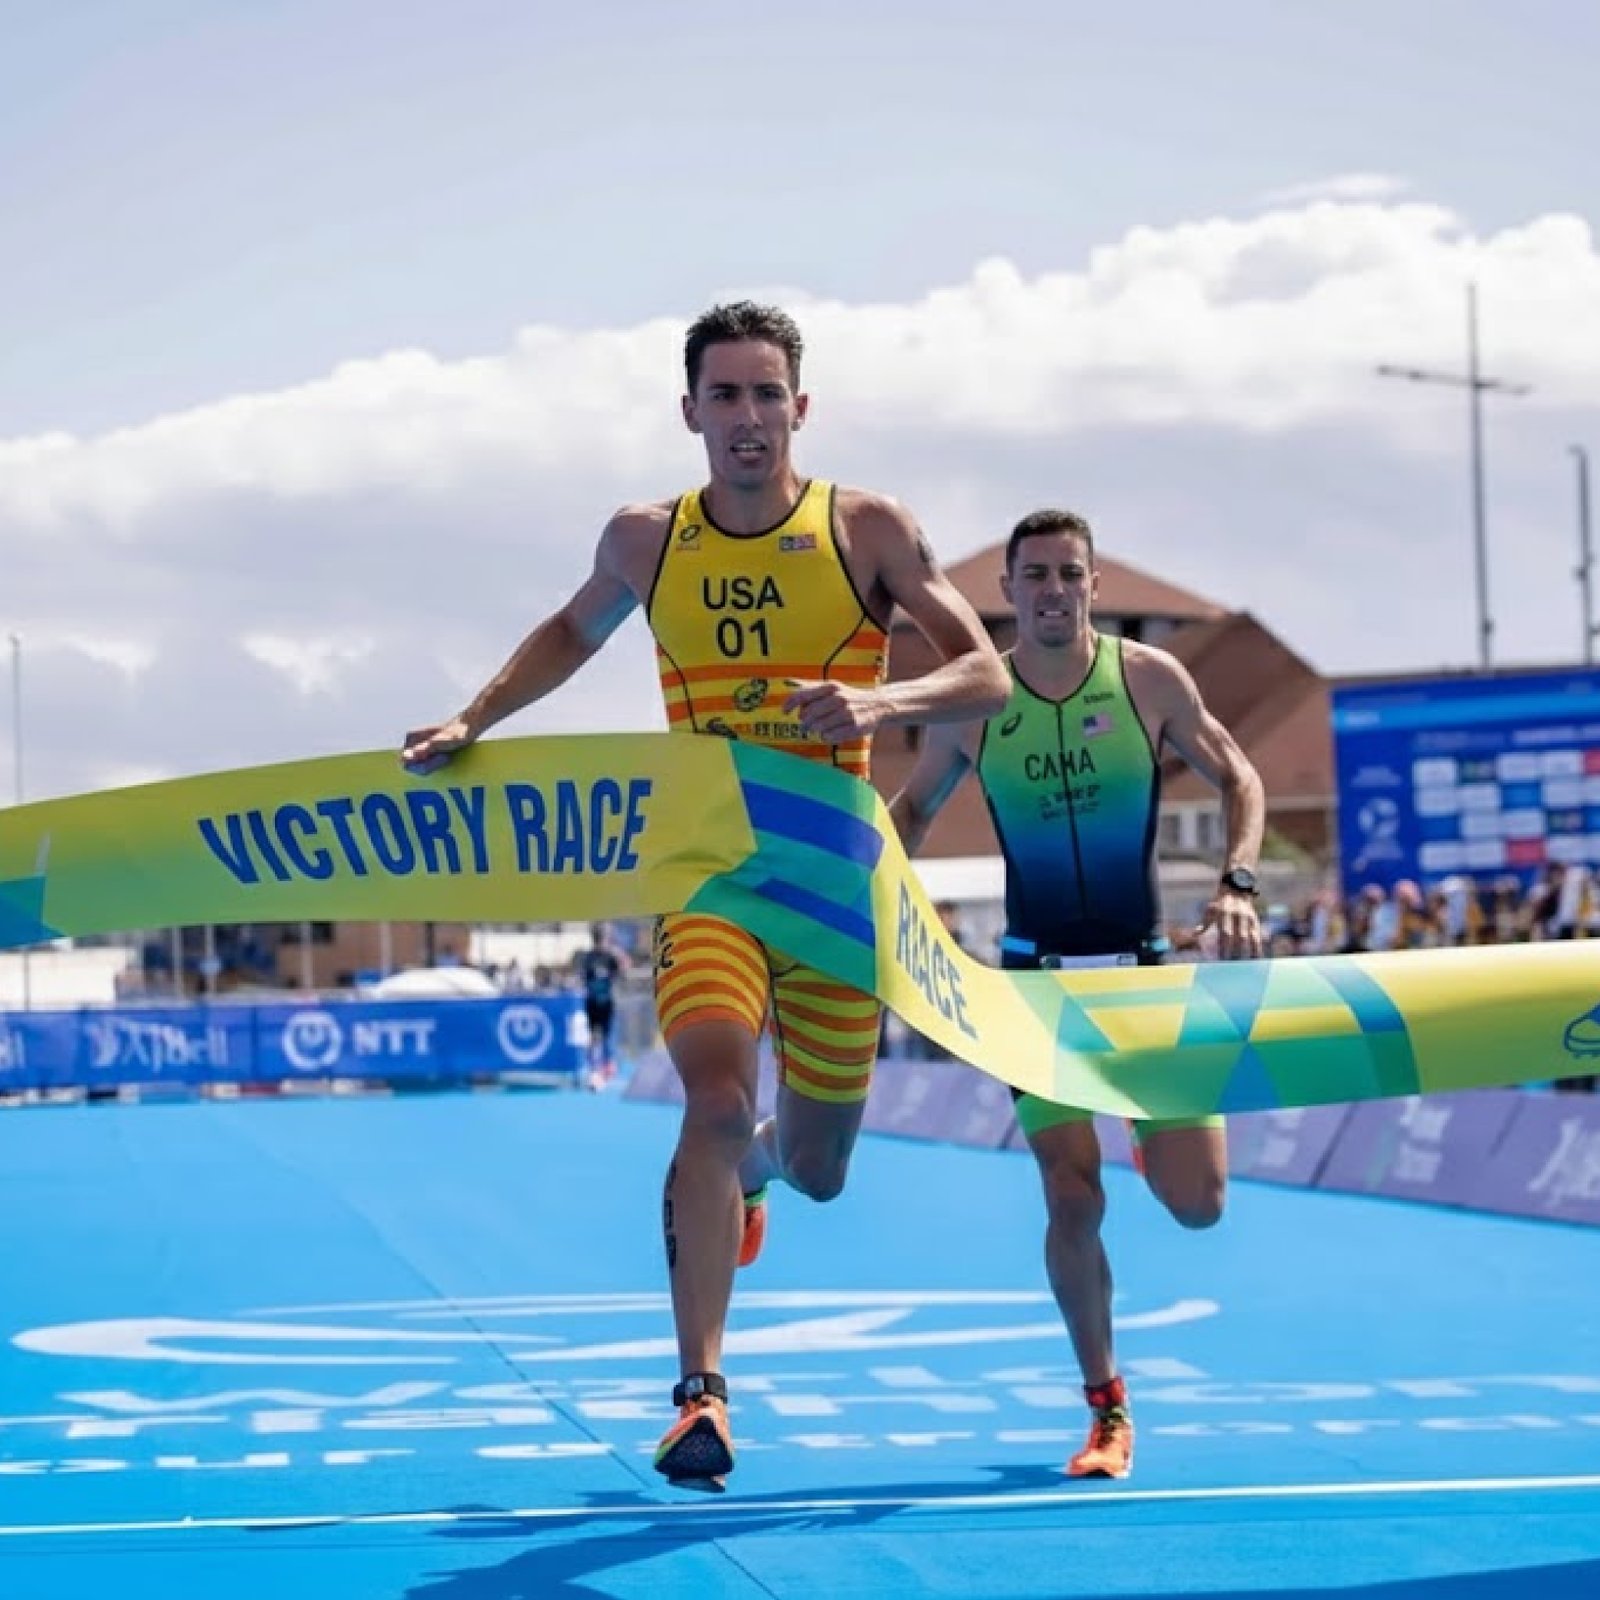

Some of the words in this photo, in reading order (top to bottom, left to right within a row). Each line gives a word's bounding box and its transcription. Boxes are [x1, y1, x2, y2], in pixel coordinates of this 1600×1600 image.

[702, 575, 785, 611] USA
[715, 616, 770, 658] 01
[197, 785, 490, 884] VICTORY
[504, 777, 653, 874] RACE
[353, 1018, 437, 1056] NTT
